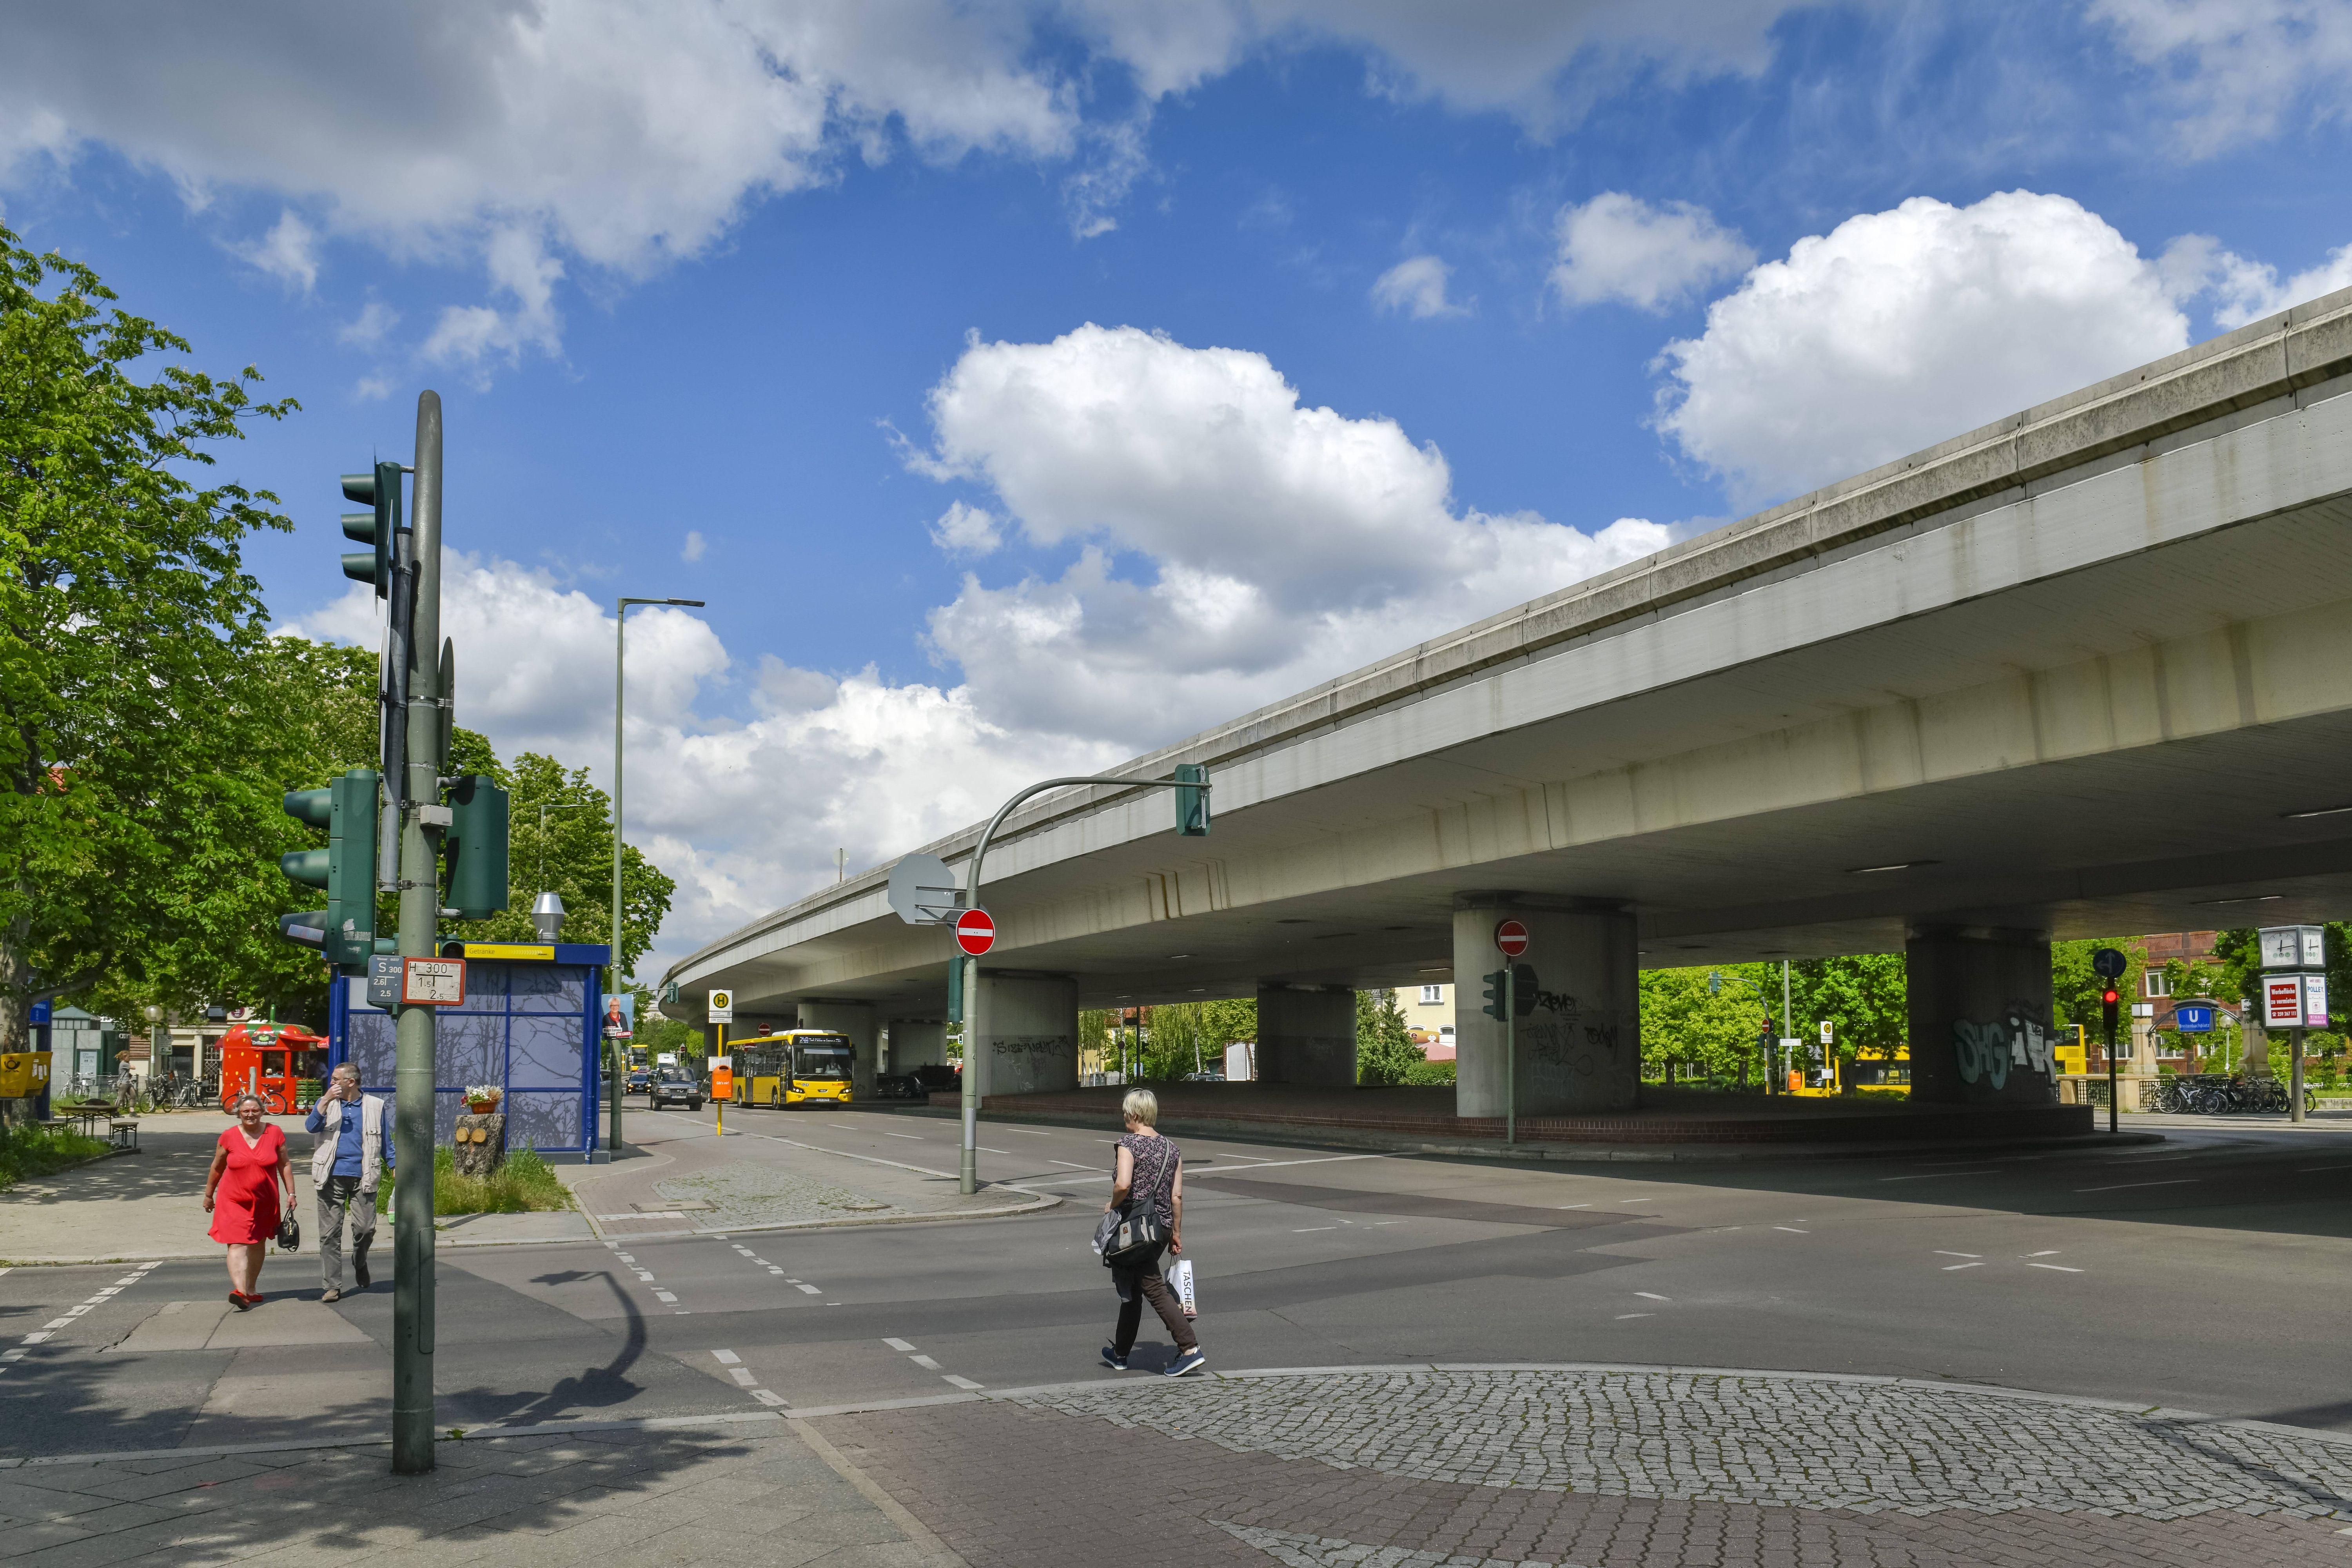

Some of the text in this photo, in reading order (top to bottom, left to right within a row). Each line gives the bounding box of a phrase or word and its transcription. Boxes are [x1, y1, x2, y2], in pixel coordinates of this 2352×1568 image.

[379, 962, 387, 972] S
[409, 963, 447, 973] H 300
[2189, 1010, 2198, 1022] U
[1183, 1270, 1192, 1312] TASCHEN
